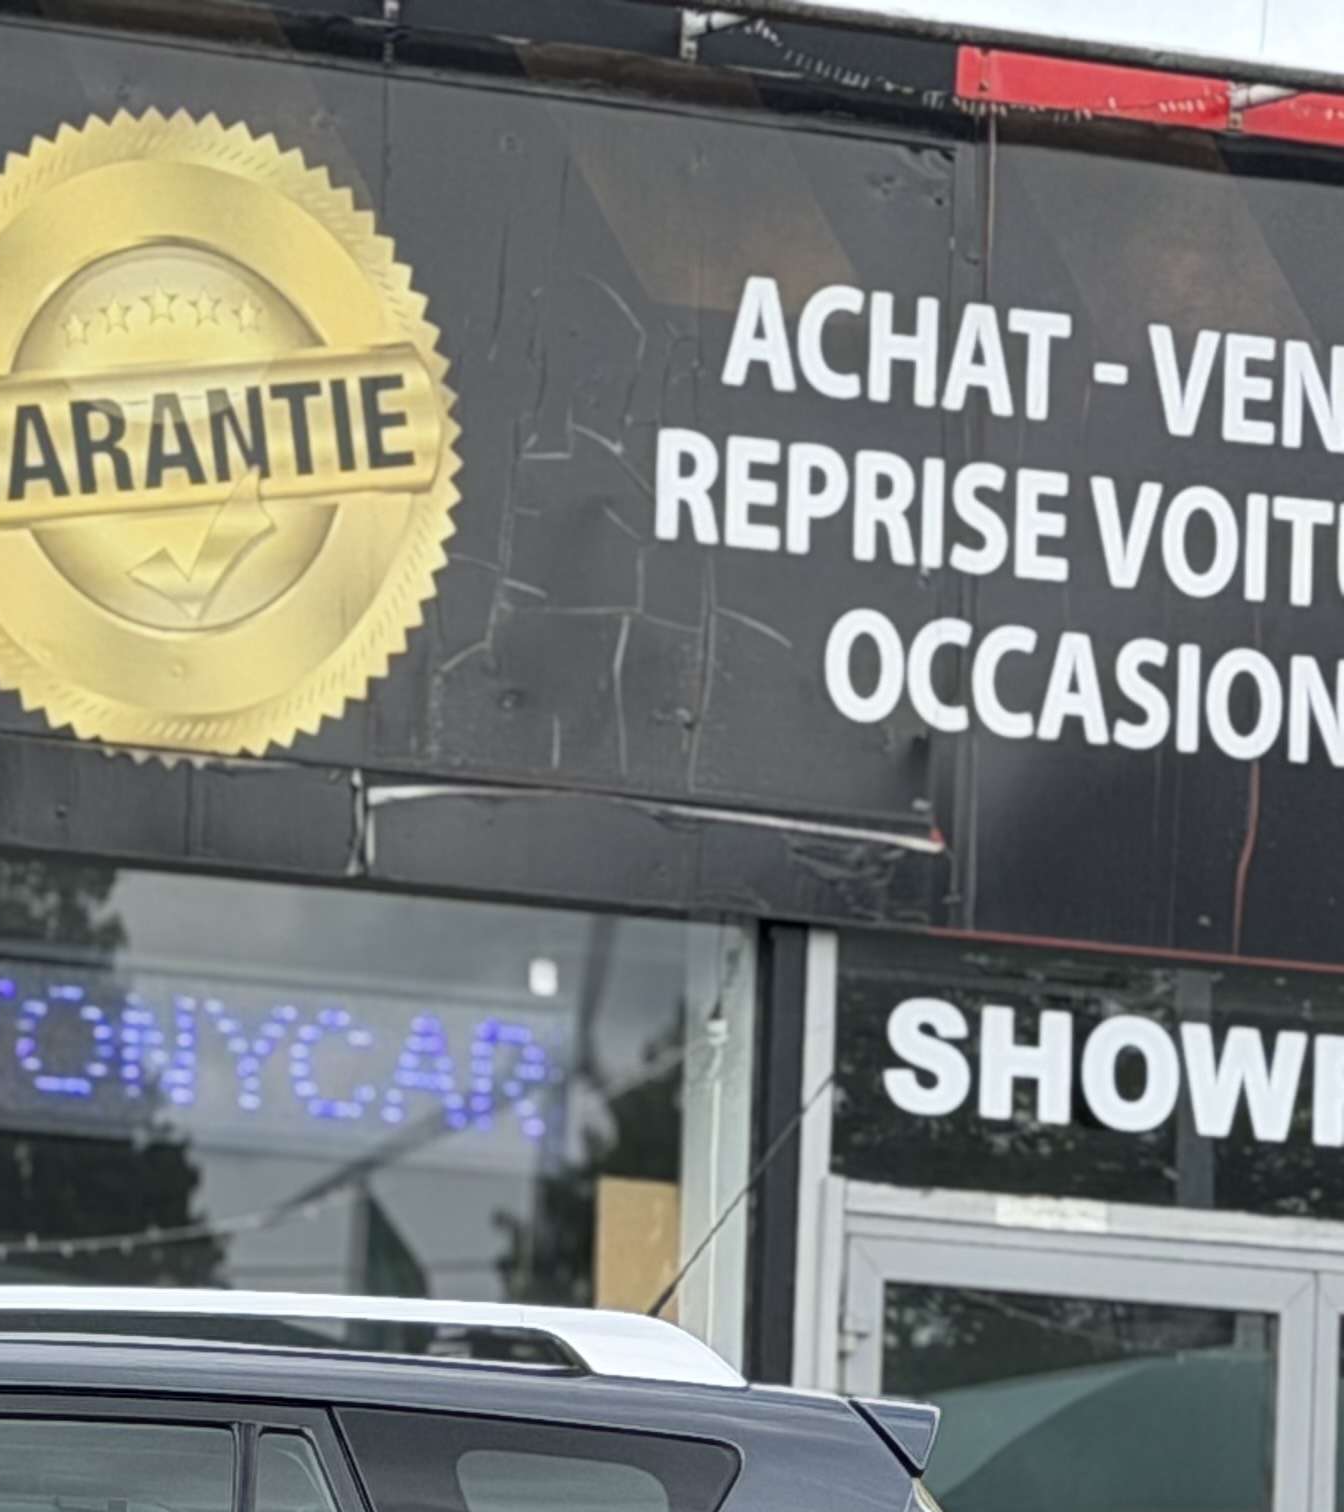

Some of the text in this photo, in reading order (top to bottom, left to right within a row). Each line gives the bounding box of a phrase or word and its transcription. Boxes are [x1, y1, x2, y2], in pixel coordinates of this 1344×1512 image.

[722, 275, 1071, 422] ACHAT
[1148, 323, 1344, 454] VEN
[655, 427, 1344, 607] REPRISE VOIT
[825, 608, 1344, 768] OCCASION
